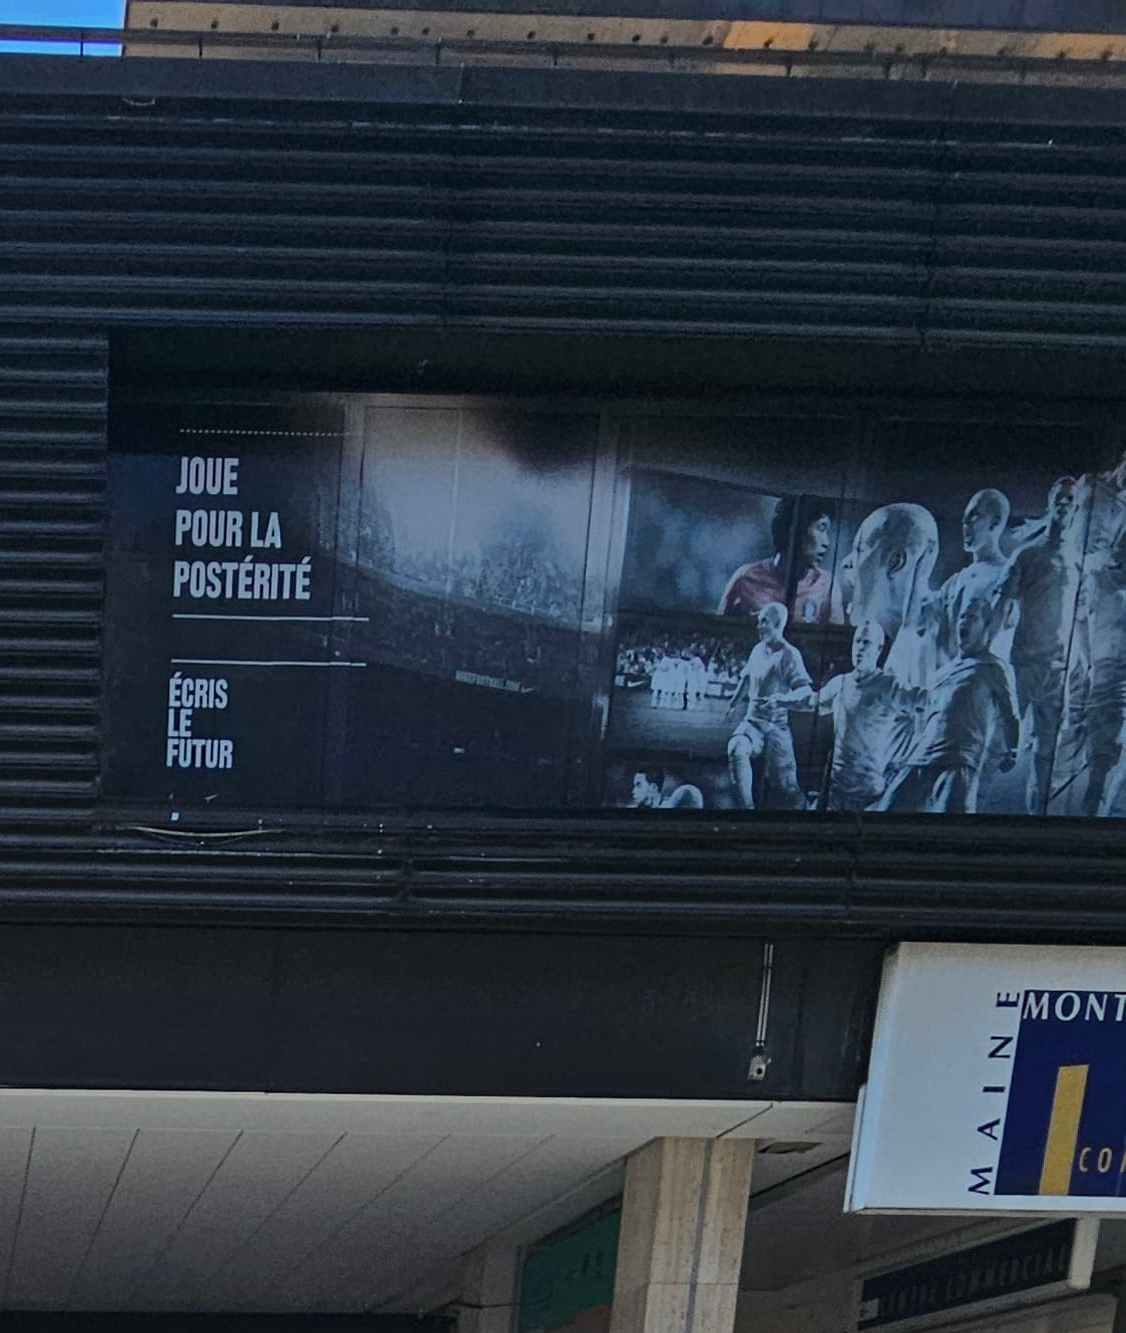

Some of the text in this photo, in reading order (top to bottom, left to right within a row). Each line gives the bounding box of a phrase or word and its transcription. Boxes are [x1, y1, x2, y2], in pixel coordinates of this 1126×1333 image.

[176, 457, 239, 495] JOUE
[175, 510, 282, 550] POUR LA
[172, 554, 312, 601] POSTÉRITÉ
[168, 673, 229, 710] ÉCRIS
[167, 709, 192, 738] LE
[165, 738, 234, 770] FUTUR
[968, 991, 1021, 1195] MAINE
